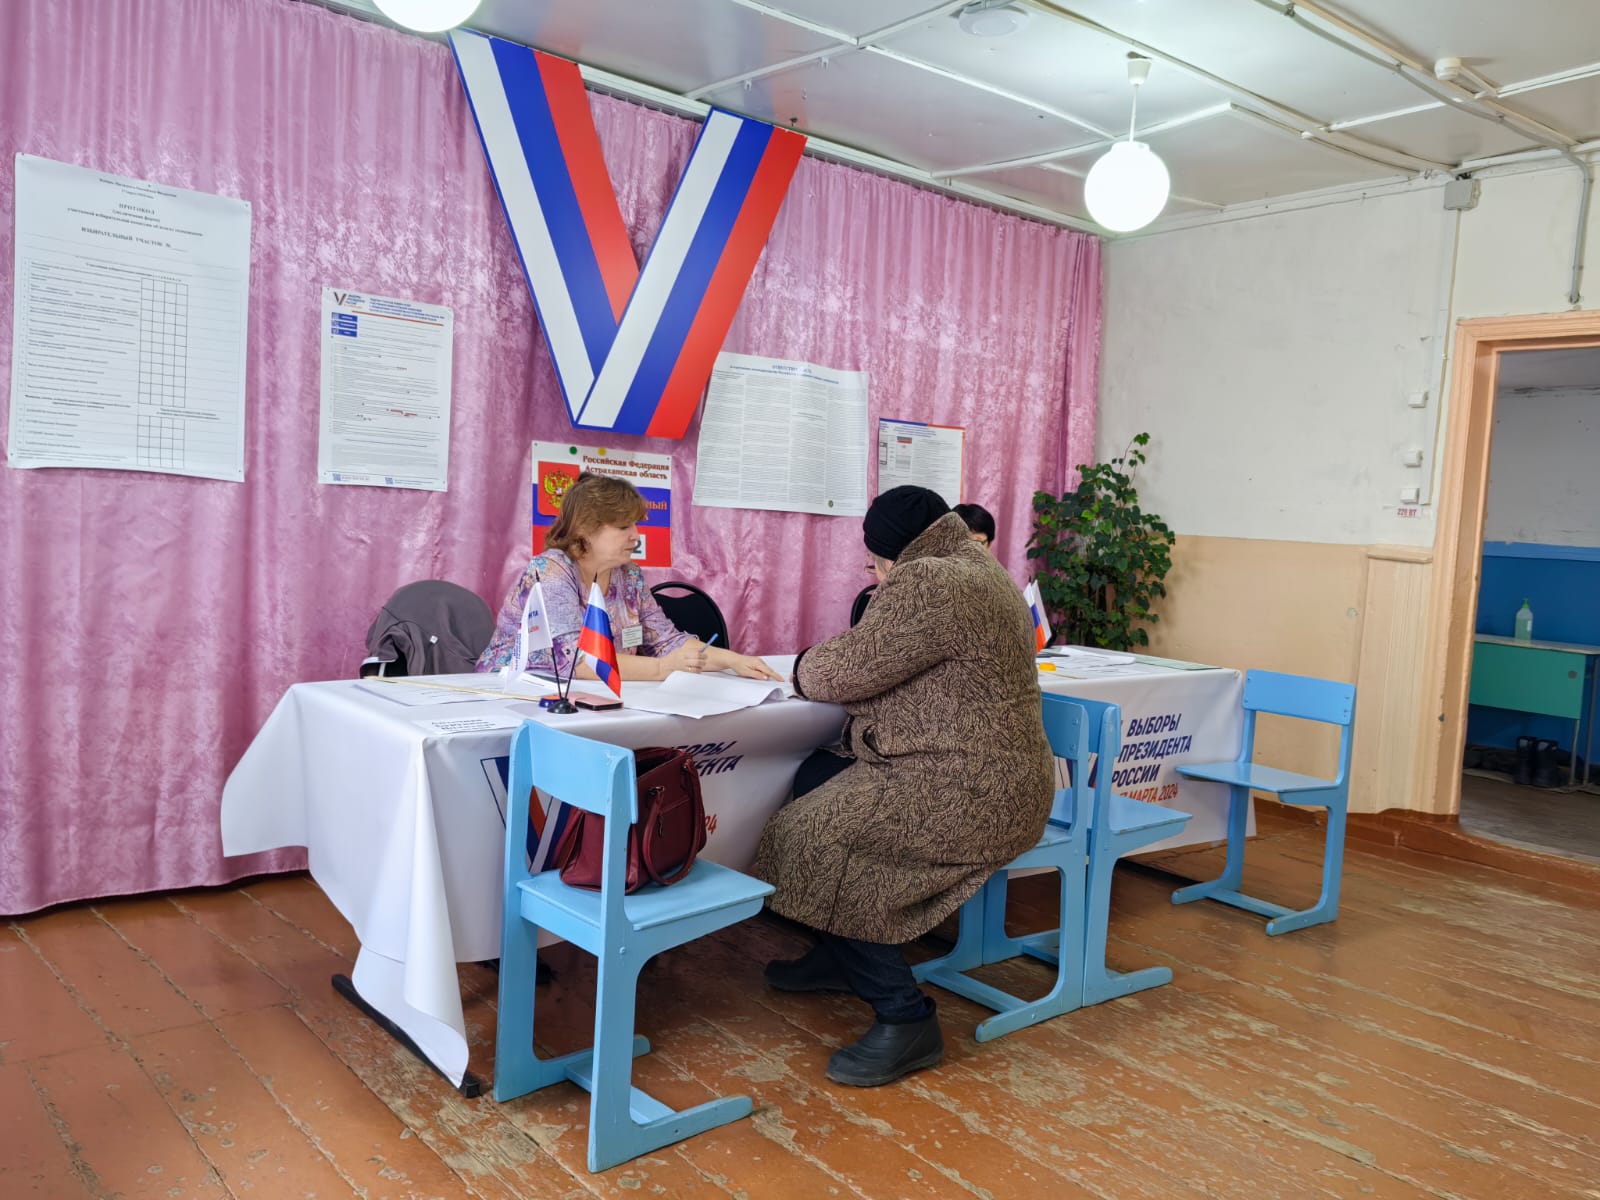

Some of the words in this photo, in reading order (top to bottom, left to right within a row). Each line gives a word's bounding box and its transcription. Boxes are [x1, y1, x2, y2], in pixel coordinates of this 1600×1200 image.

[582, 455, 627, 467] Российская
[628, 460, 670, 471] Федерация
[585, 465, 638, 477] Астраханская
[639, 470, 668, 480] область
[1126, 713, 1182, 738] ВЫБОРЫ
[1118, 735, 1193, 763] ПРЕЗИДЕНТА
[1112, 764, 1161, 788] РОССИИ
[1157, 782, 1179, 802] 2024
